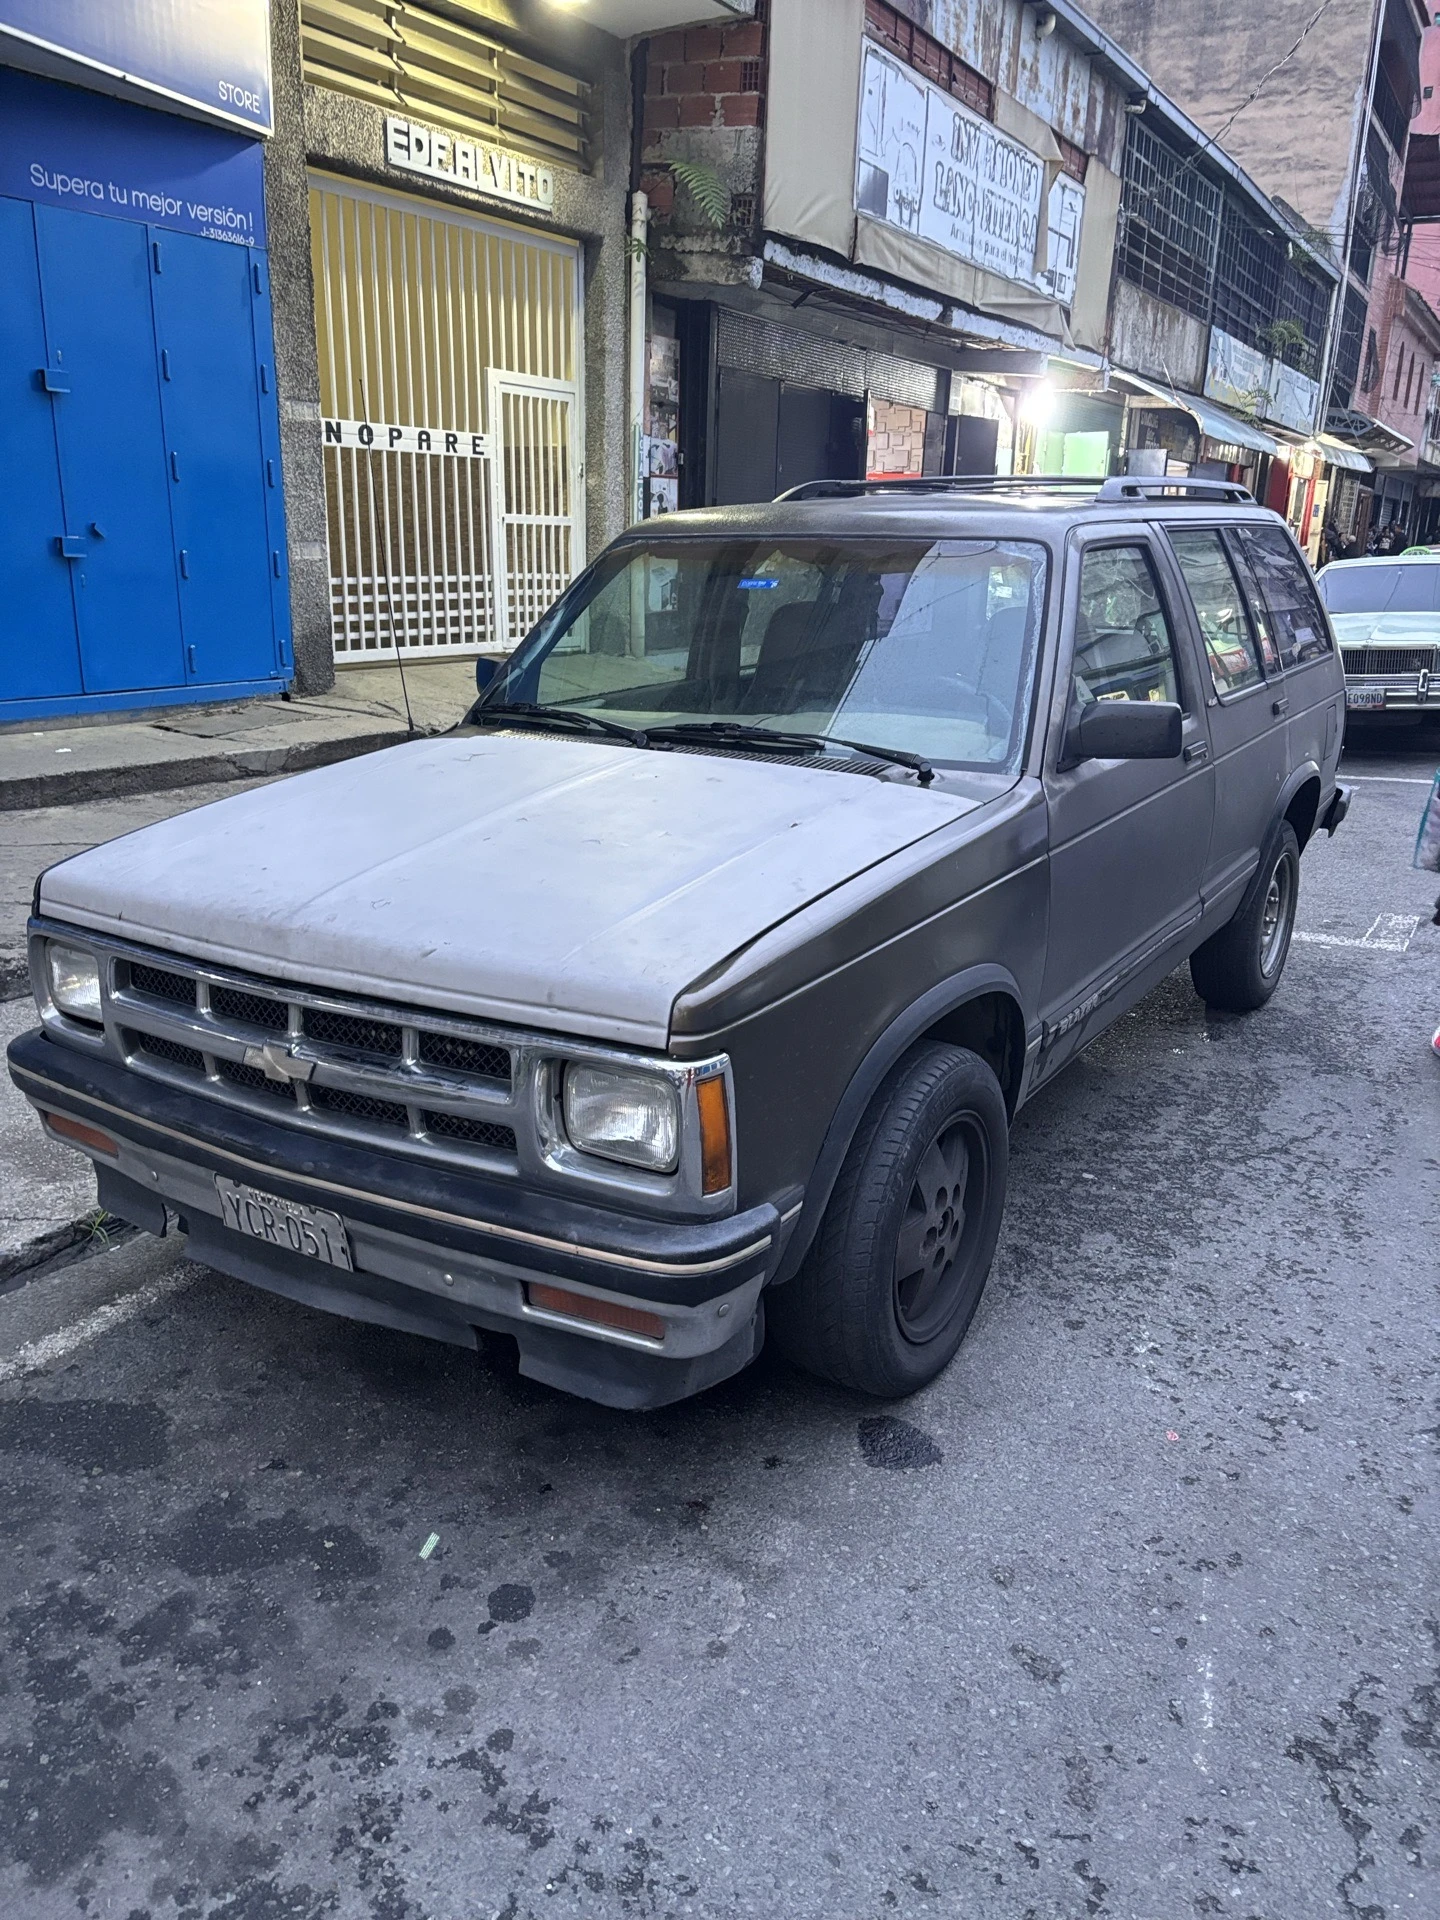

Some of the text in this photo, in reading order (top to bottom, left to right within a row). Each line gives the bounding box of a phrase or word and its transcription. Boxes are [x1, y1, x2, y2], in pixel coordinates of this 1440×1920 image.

[218, 80, 261, 114] STORE
[952, 112, 1038, 202] INVRSIONES
[29, 163, 105, 200] Supera
[108, 181, 128, 205] tu
[131, 189, 183, 218] mejor
[226, 1191, 334, 1264] YCR-051
